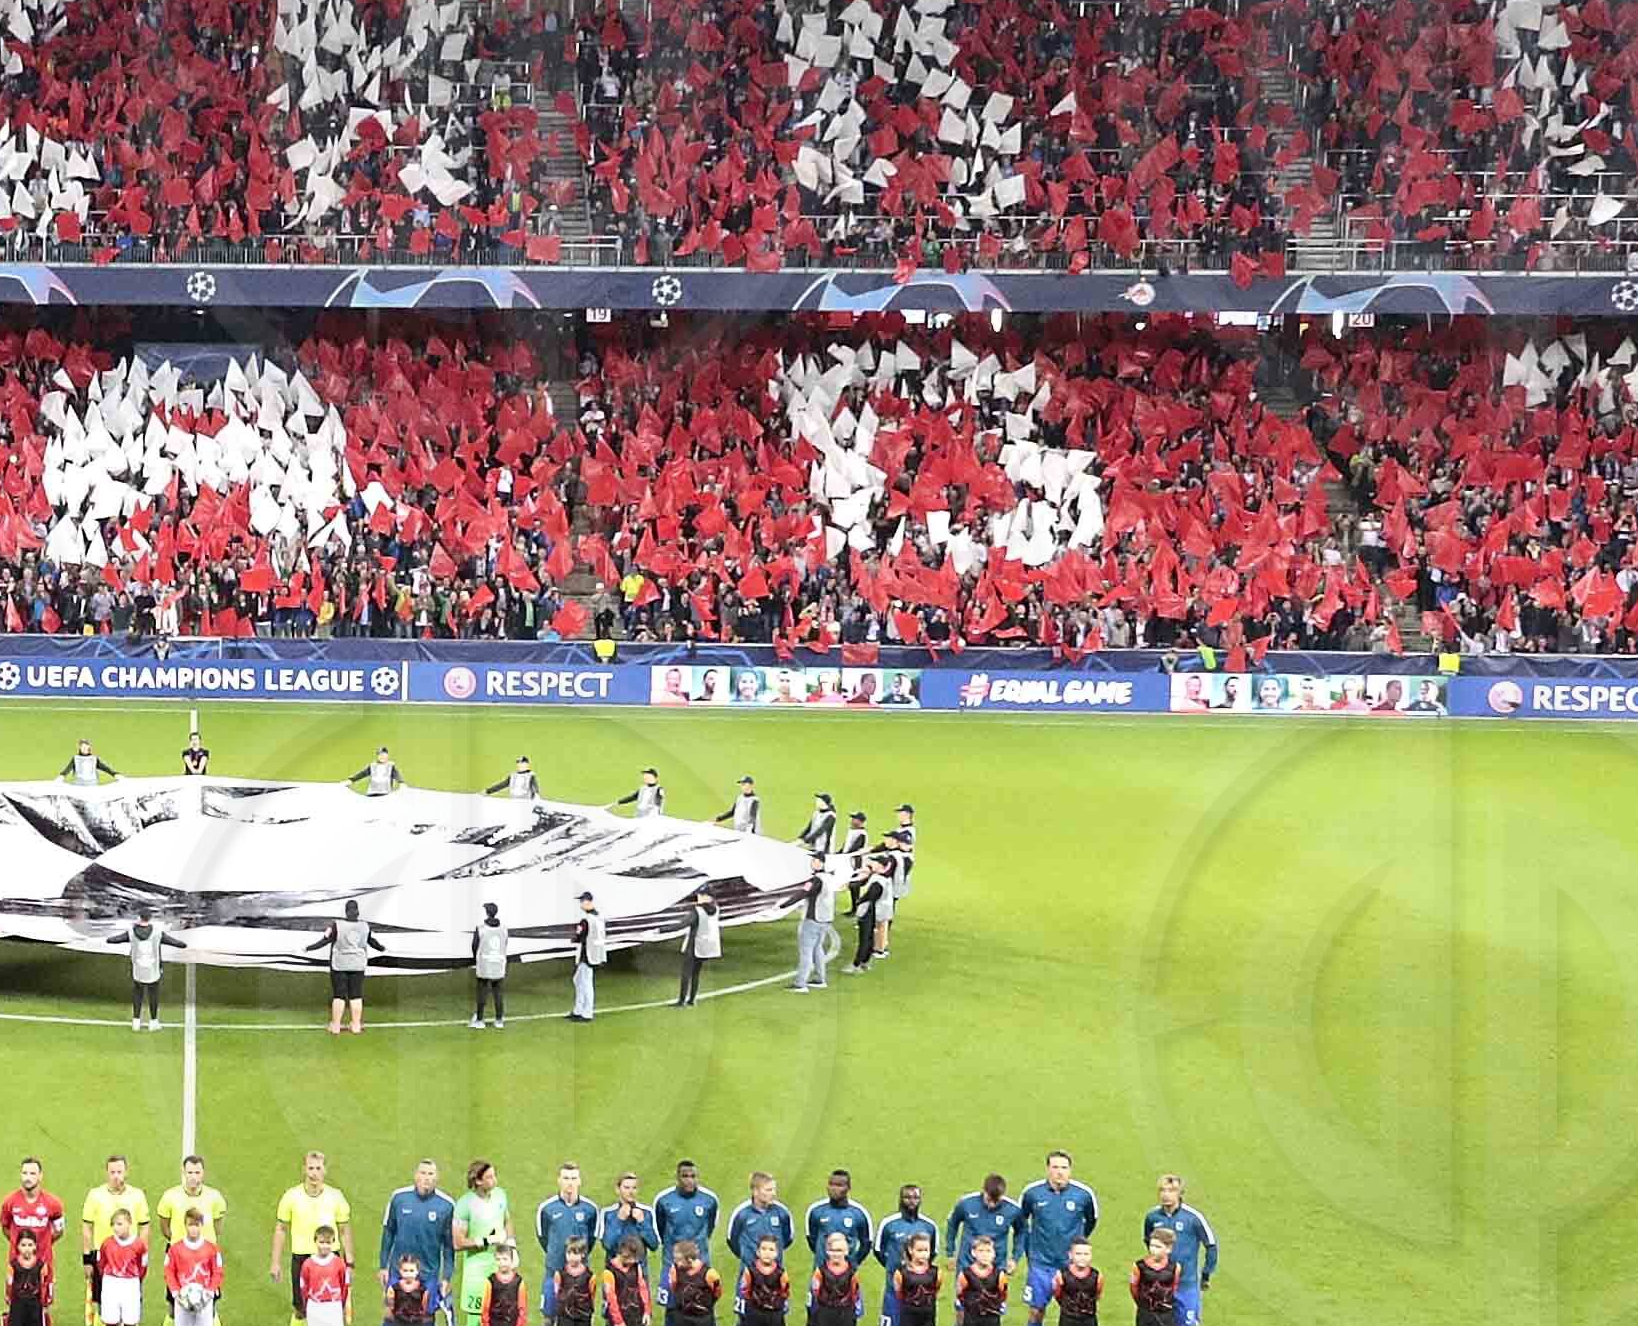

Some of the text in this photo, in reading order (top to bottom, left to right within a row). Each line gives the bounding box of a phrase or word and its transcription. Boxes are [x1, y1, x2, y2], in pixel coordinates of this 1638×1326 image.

[590, 309, 607, 321] 19
[1352, 313, 1371, 325] 20
[27, 665, 364, 692] UEFA CHAMPIONS LEAGUE
[485, 670, 614, 699] RESPECT
[467, 1294, 483, 1310] 28
